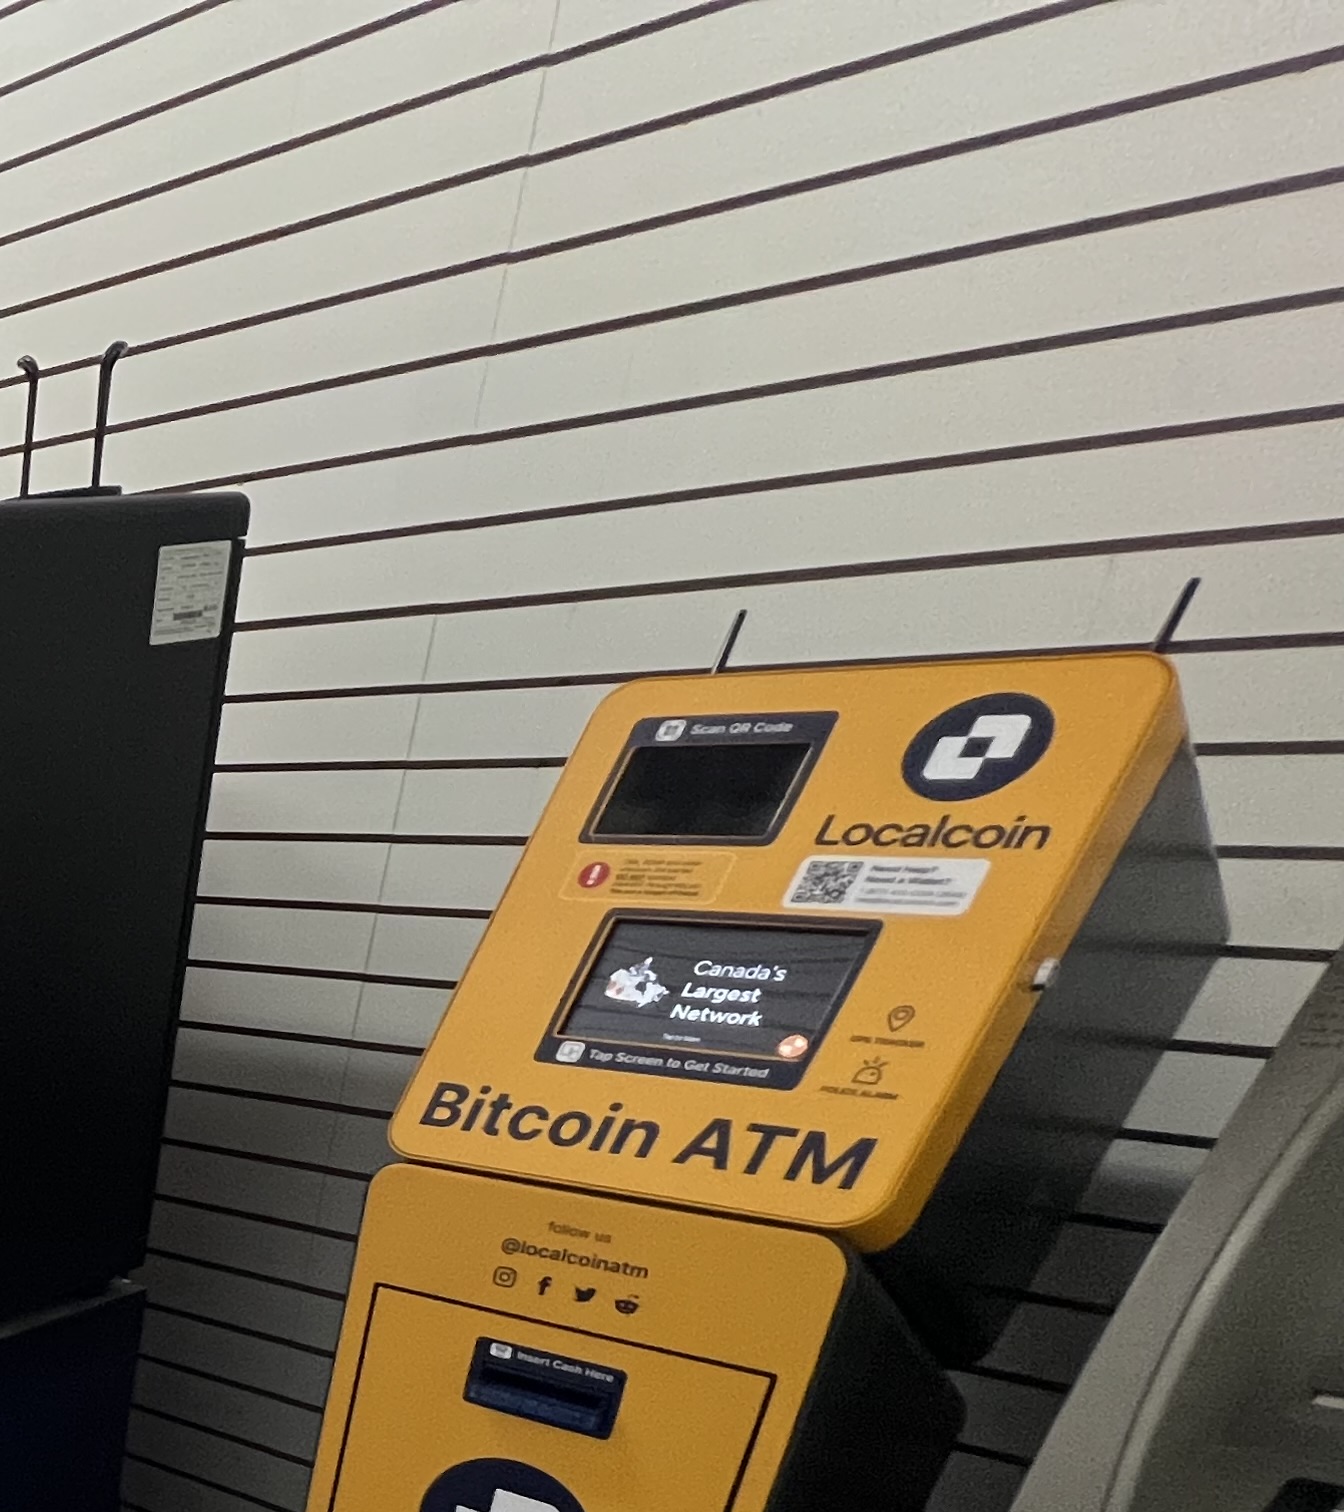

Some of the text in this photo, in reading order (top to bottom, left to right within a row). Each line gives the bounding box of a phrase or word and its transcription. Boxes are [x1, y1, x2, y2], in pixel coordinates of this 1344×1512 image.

[690, 721, 794, 735] Scan QR Code
[814, 814, 1052, 850] Localcoin
[694, 959, 787, 982] Canada's
[681, 982, 761, 1004] Largest
[670, 1003, 763, 1028] Network
[589, 1048, 770, 1079] Tap Screen to Get Started
[419, 1082, 878, 1191] Bitcoin ATM
[548, 1221, 612, 1243] follow us
[501, 1237, 649, 1279] @localcoinatm
[517, 1352, 614, 1383] Insert Cash Here
